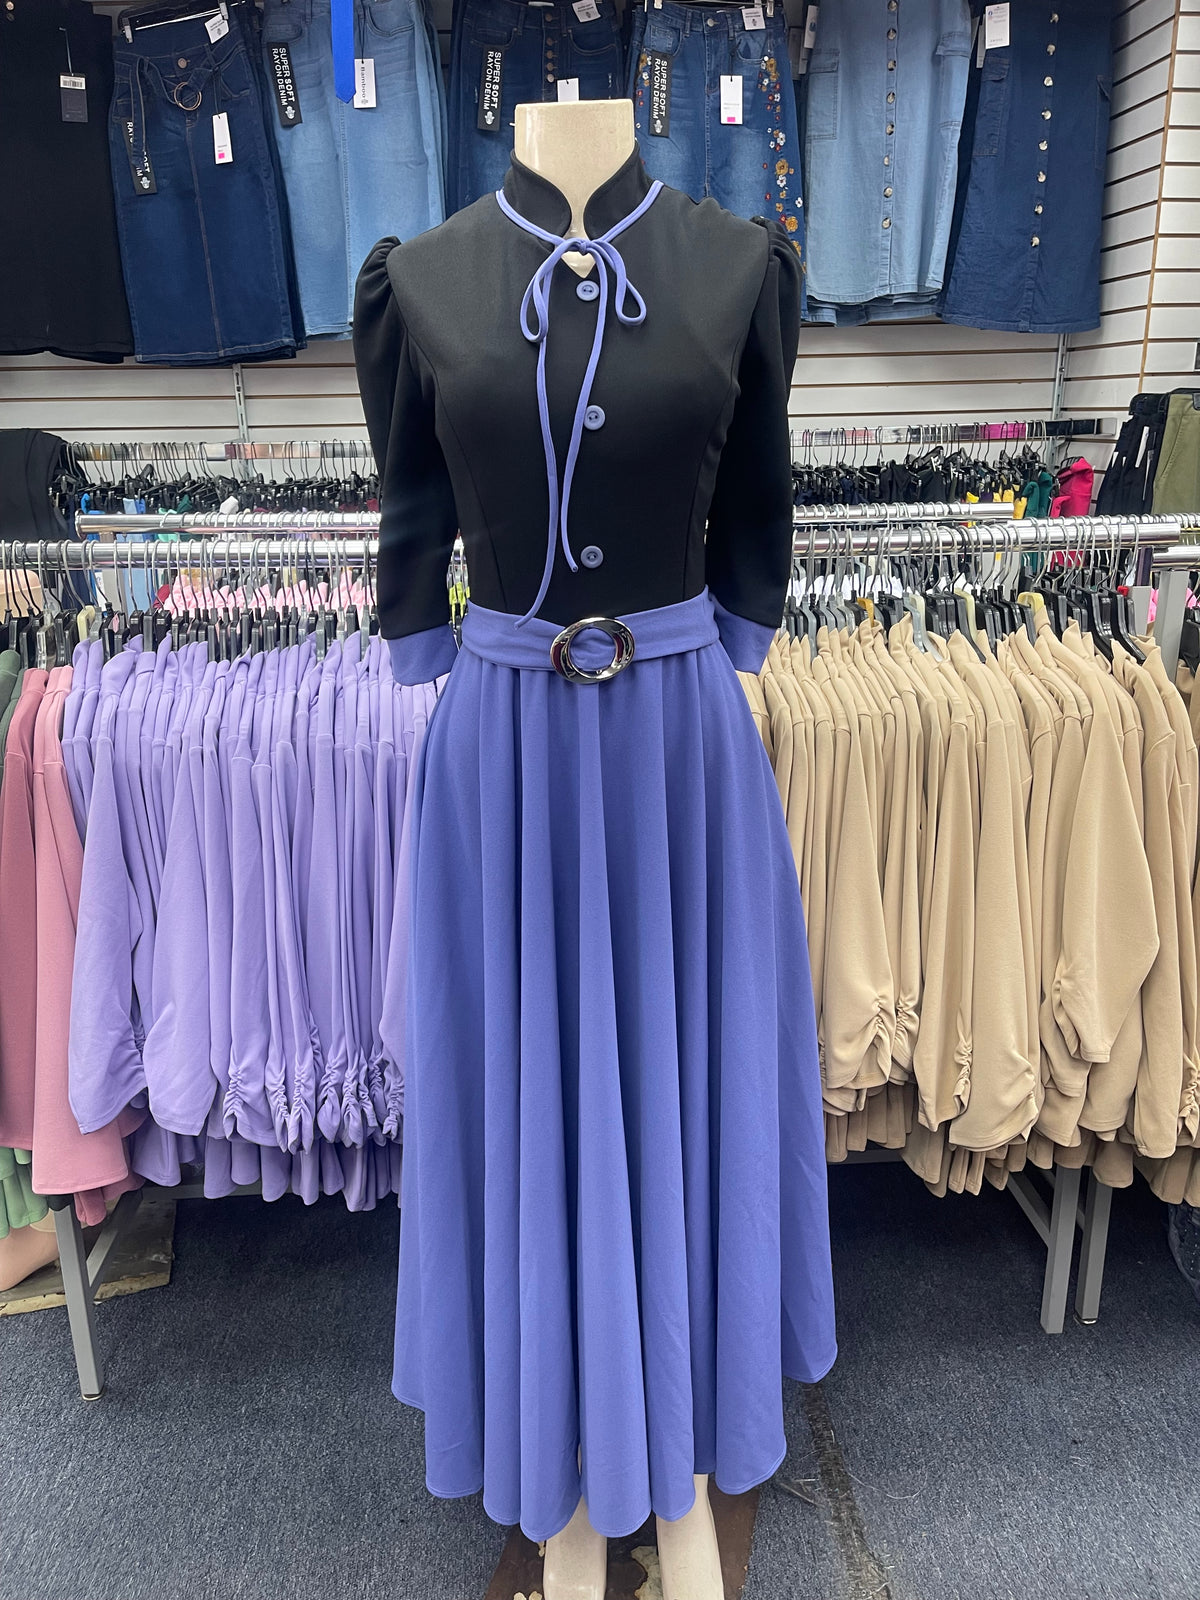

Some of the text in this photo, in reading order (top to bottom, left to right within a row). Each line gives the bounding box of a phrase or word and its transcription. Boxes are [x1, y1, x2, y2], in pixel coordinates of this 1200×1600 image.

[272, 48, 288, 106] RAYON DENIM
[279, 47, 295, 102] SUPER SOFT
[483, 51, 494, 110] RAYON DENIM
[491, 51, 502, 109] SUPER SOFT
[652, 58, 661, 119] RAYON DENIM
